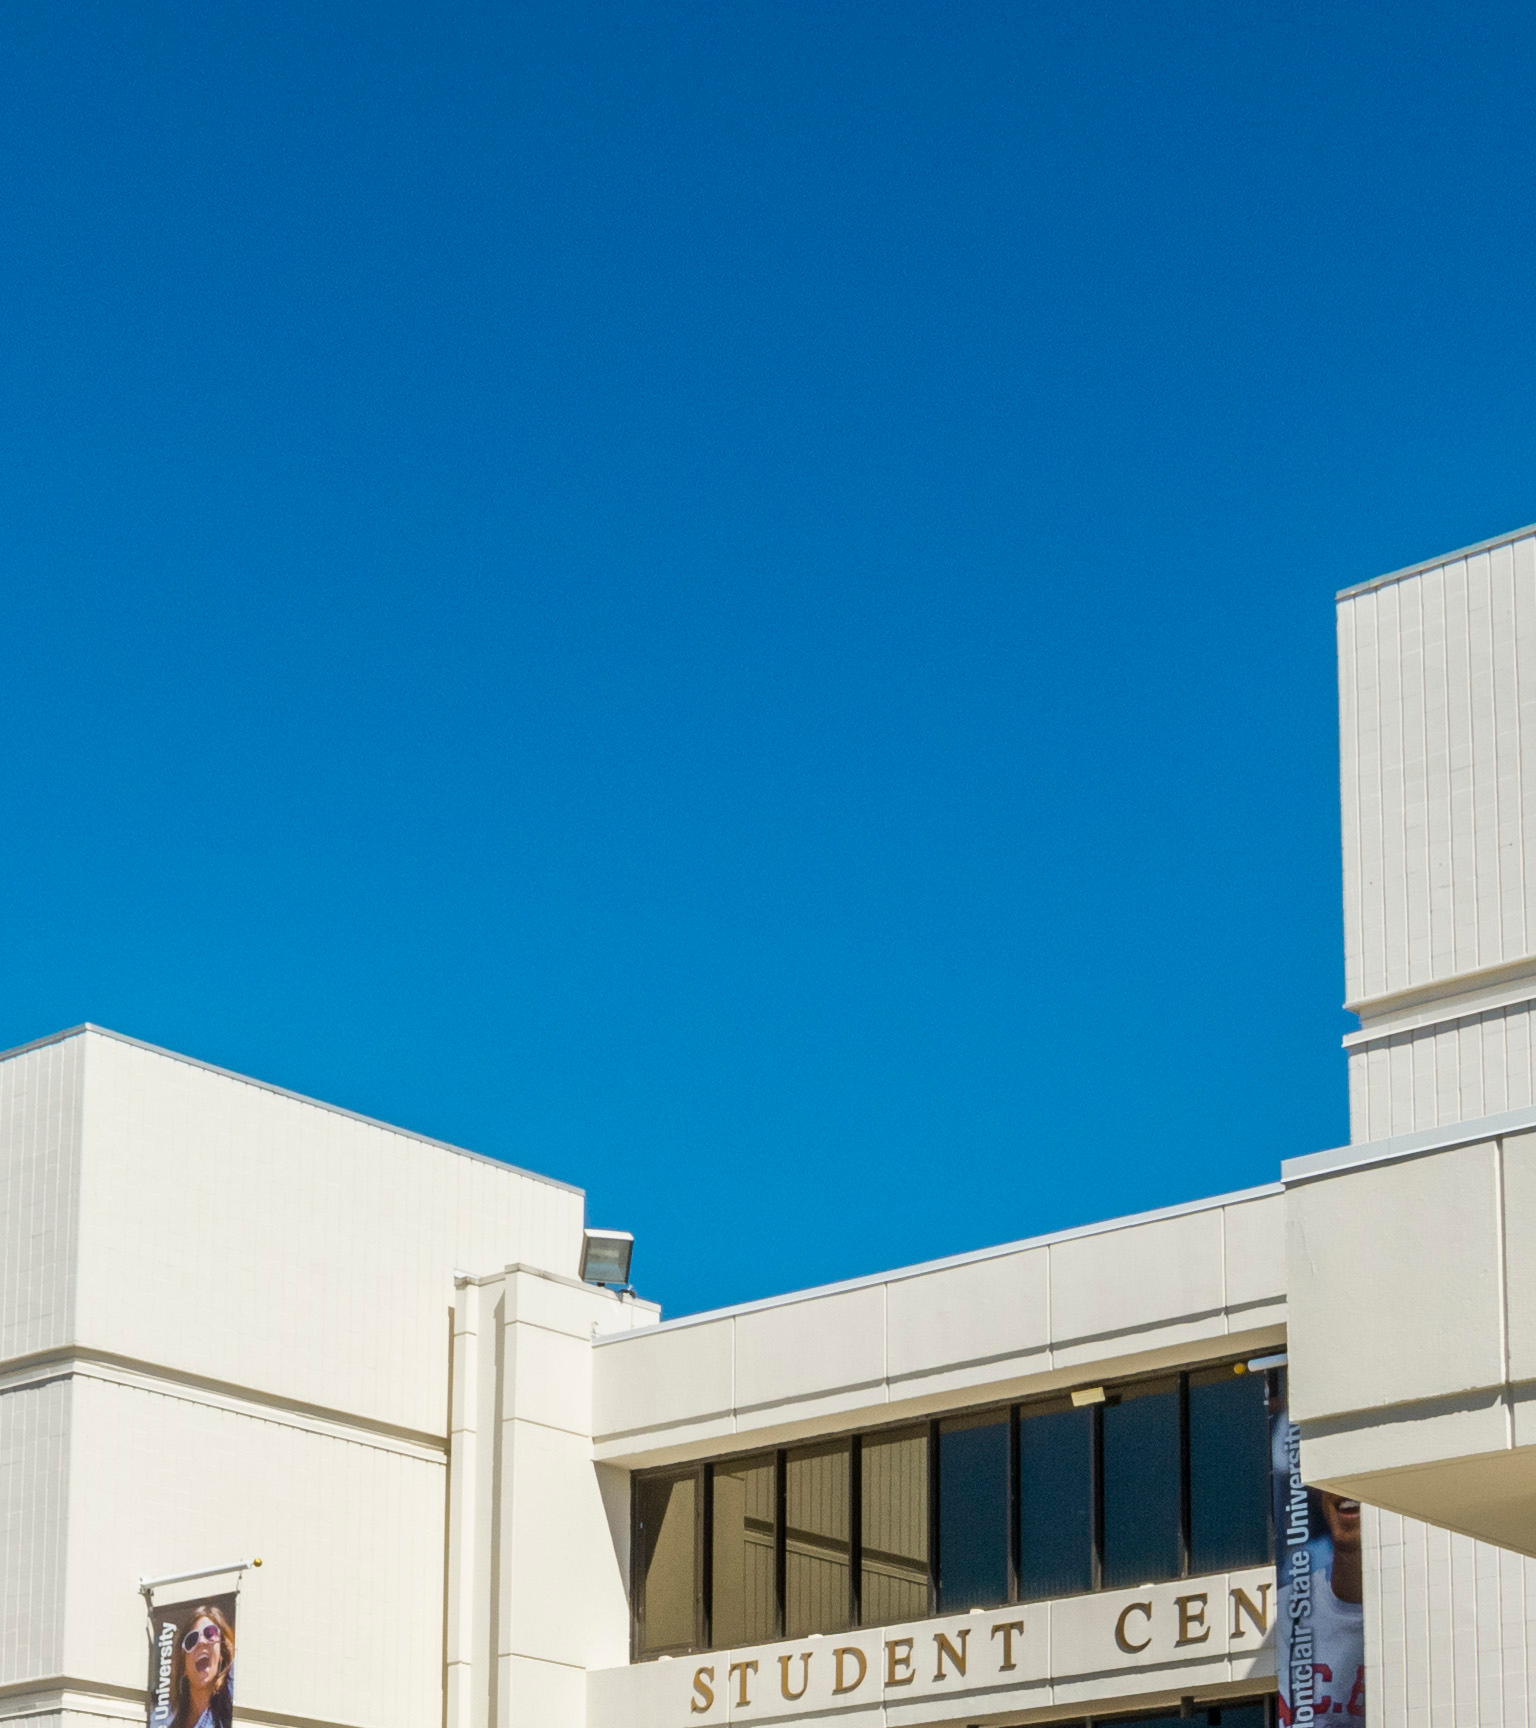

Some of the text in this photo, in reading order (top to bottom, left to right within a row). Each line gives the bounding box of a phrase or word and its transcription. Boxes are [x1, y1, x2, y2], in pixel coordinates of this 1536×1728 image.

[1289, 1551, 1312, 1619] State
[155, 1622, 177, 1720] University
[691, 1619, 1025, 1714] STUDENT
